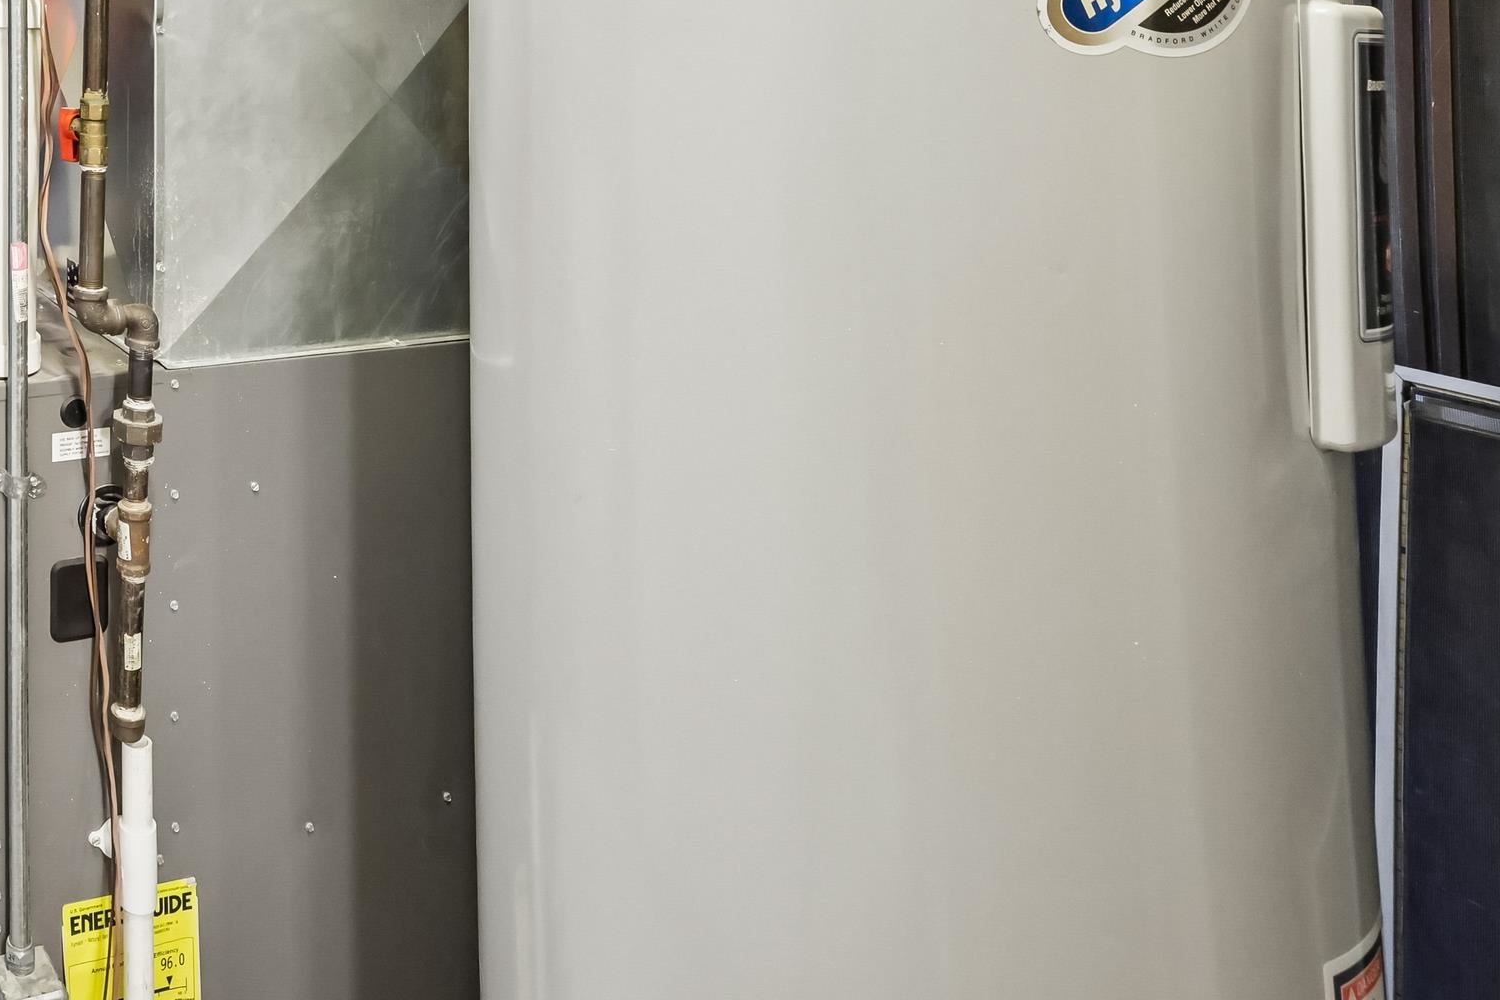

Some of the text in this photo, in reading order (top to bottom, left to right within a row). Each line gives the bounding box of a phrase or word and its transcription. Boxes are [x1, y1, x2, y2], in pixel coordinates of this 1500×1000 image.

[1177, 5, 1196, 22] Lower
[1191, 8, 1208, 24] More
[1205, 0, 1217, 12] Hot
[1131, 29, 1194, 45] BRADFORD
[1200, 14, 1229, 38] WHITE
[160, 952, 185, 972] 96.0
